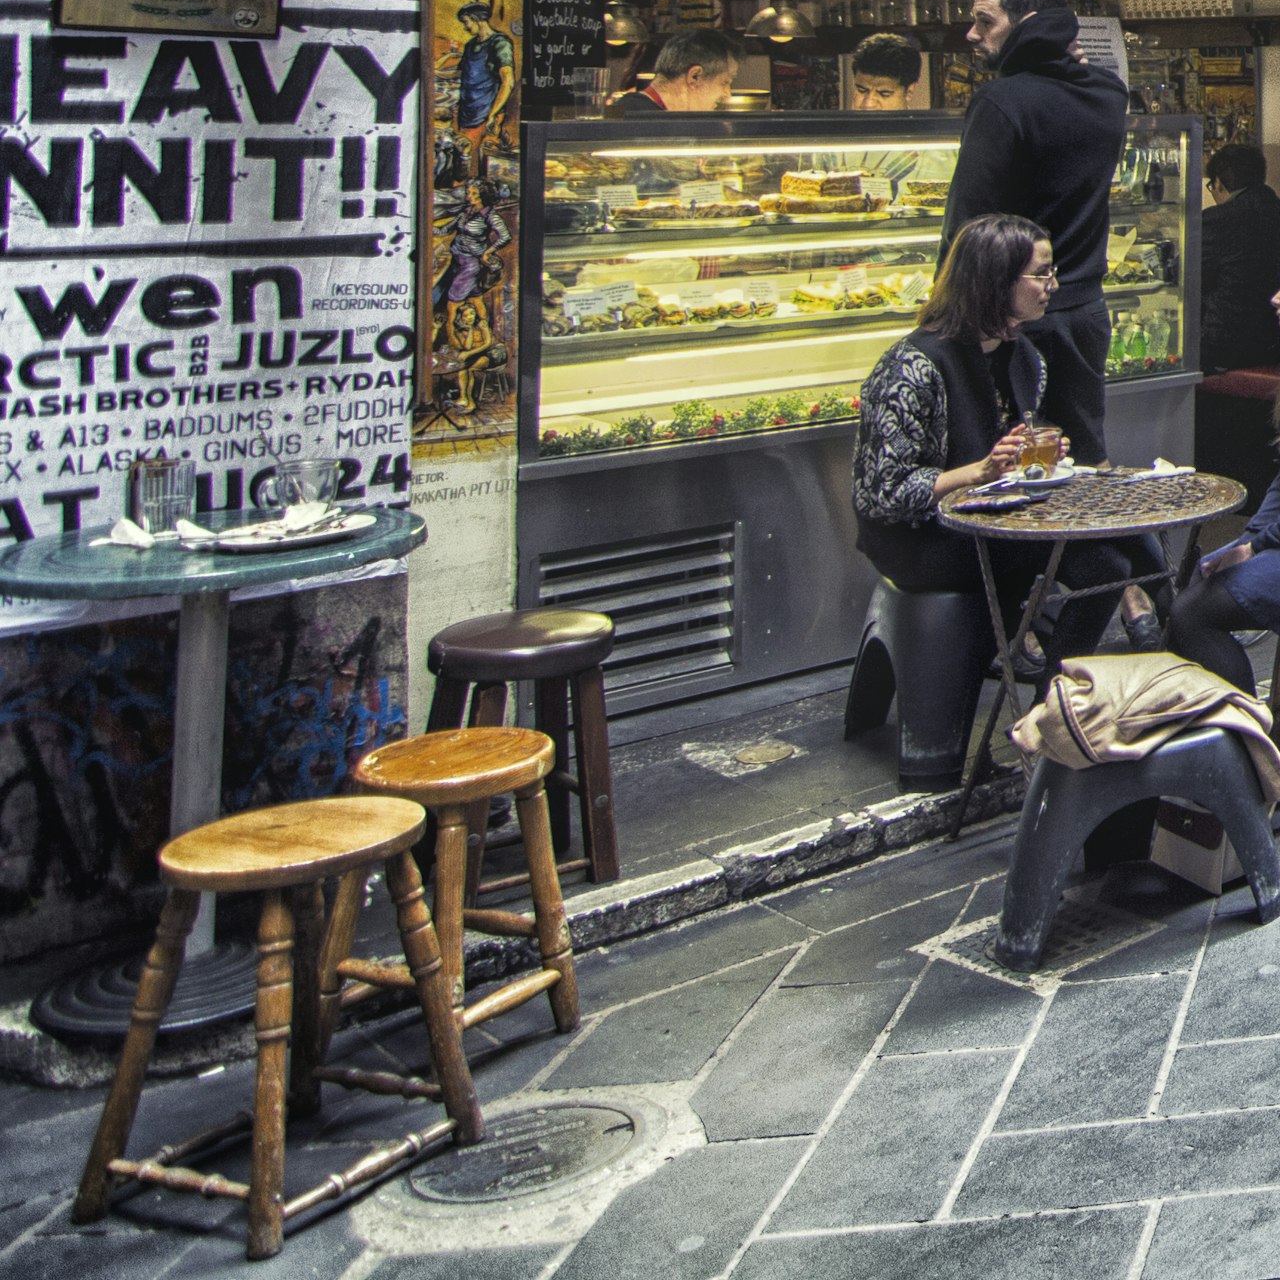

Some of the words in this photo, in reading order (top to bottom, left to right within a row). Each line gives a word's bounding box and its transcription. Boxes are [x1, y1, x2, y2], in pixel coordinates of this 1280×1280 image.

[582, 19, 602, 38] soup
[547, 35, 575, 65] garlic
[582, 44, 592, 55] or
[0, 33, 420, 124] EAVY
[533, 66, 555, 88] herb
[331, 282, 408, 298] (KEYSOUND
[188, 333, 209, 377] B2B
[220, 324, 413, 371] JUZLO
[96, 379, 282, 413] BROTHERS
[59, 424, 109, 449] A13
[145, 410, 272, 441] BADDUMS
[304, 397, 413, 427] 2FUDDH
[204, 434, 301, 462] GINGUS
[470, 480, 491, 496] PTY
